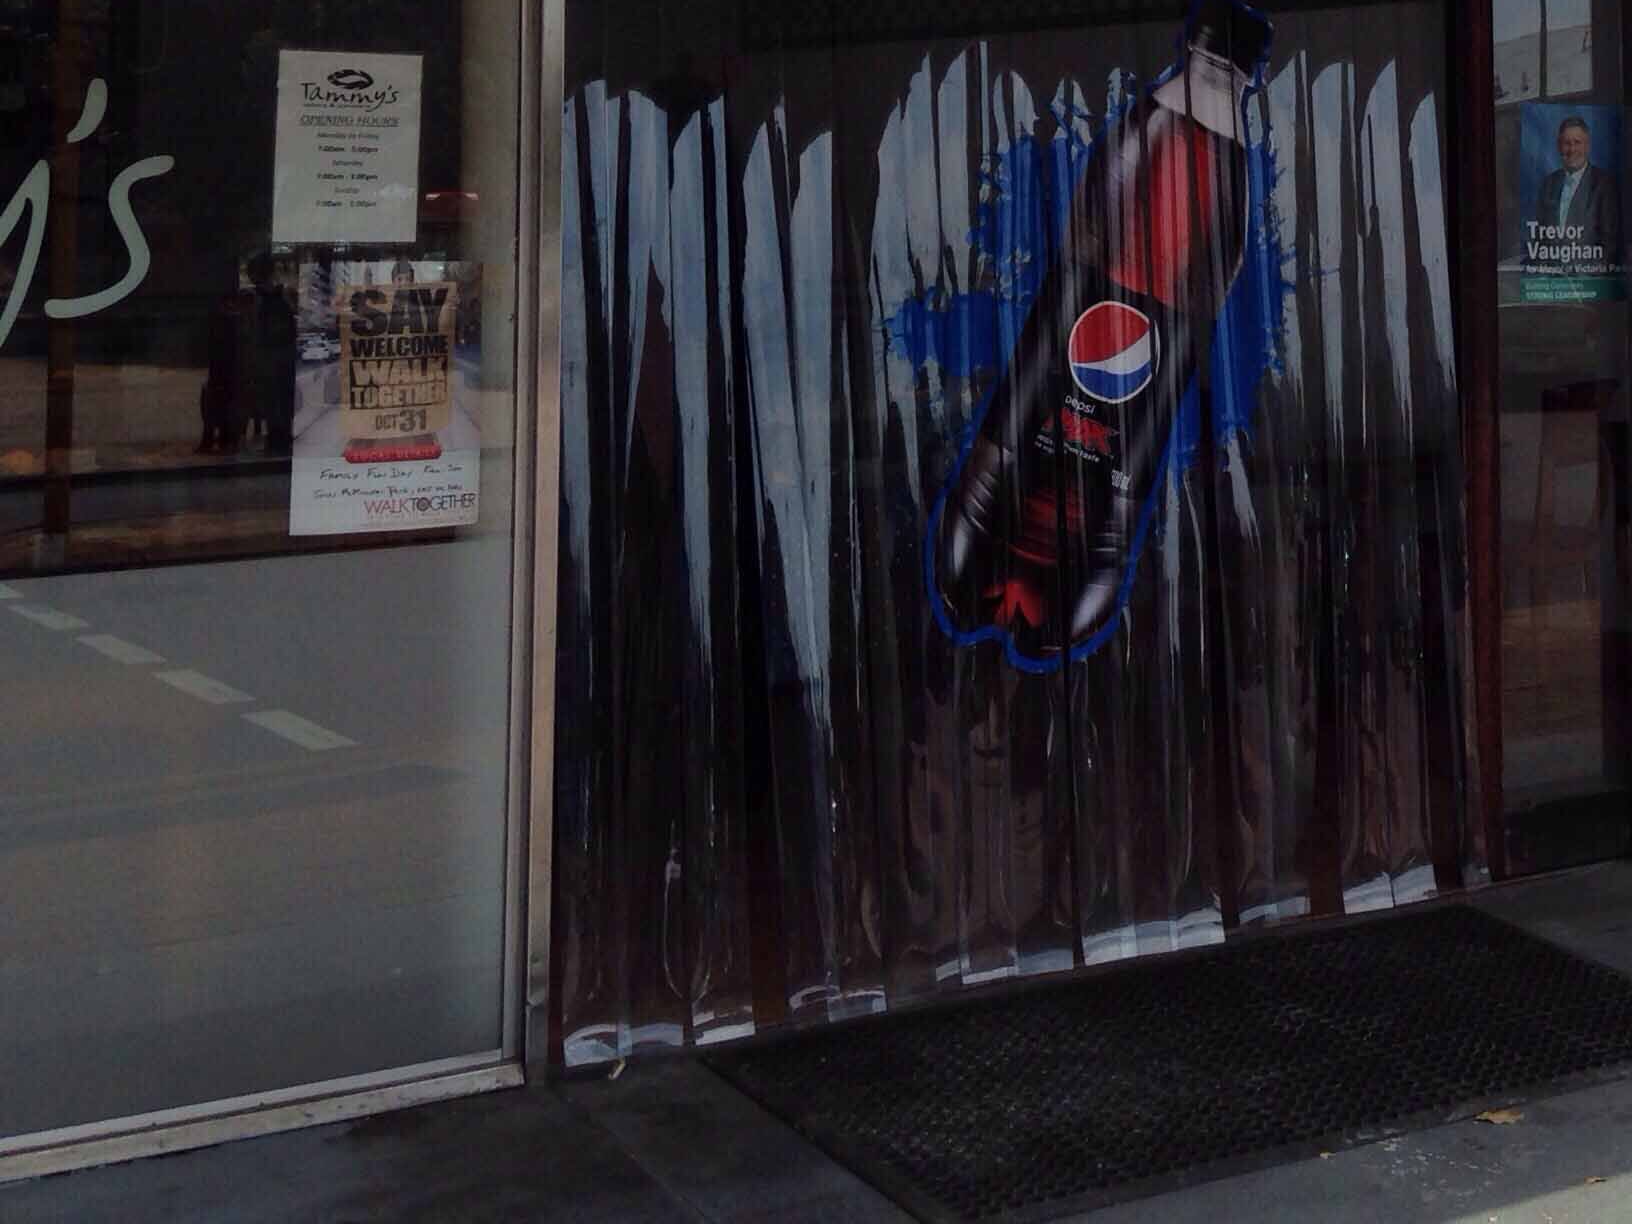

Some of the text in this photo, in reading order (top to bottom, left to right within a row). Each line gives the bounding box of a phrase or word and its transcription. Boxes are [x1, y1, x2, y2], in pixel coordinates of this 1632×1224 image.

[300, 81, 400, 112] Tammy's
[1526, 220, 1585, 240] Trevor
[1526, 241, 1604, 263] Vaughan
[350, 288, 449, 336] SAY
[350, 337, 448, 357] WELCOME
[1063, 394, 1097, 416] pepsi
[399, 409, 428, 433] 31
